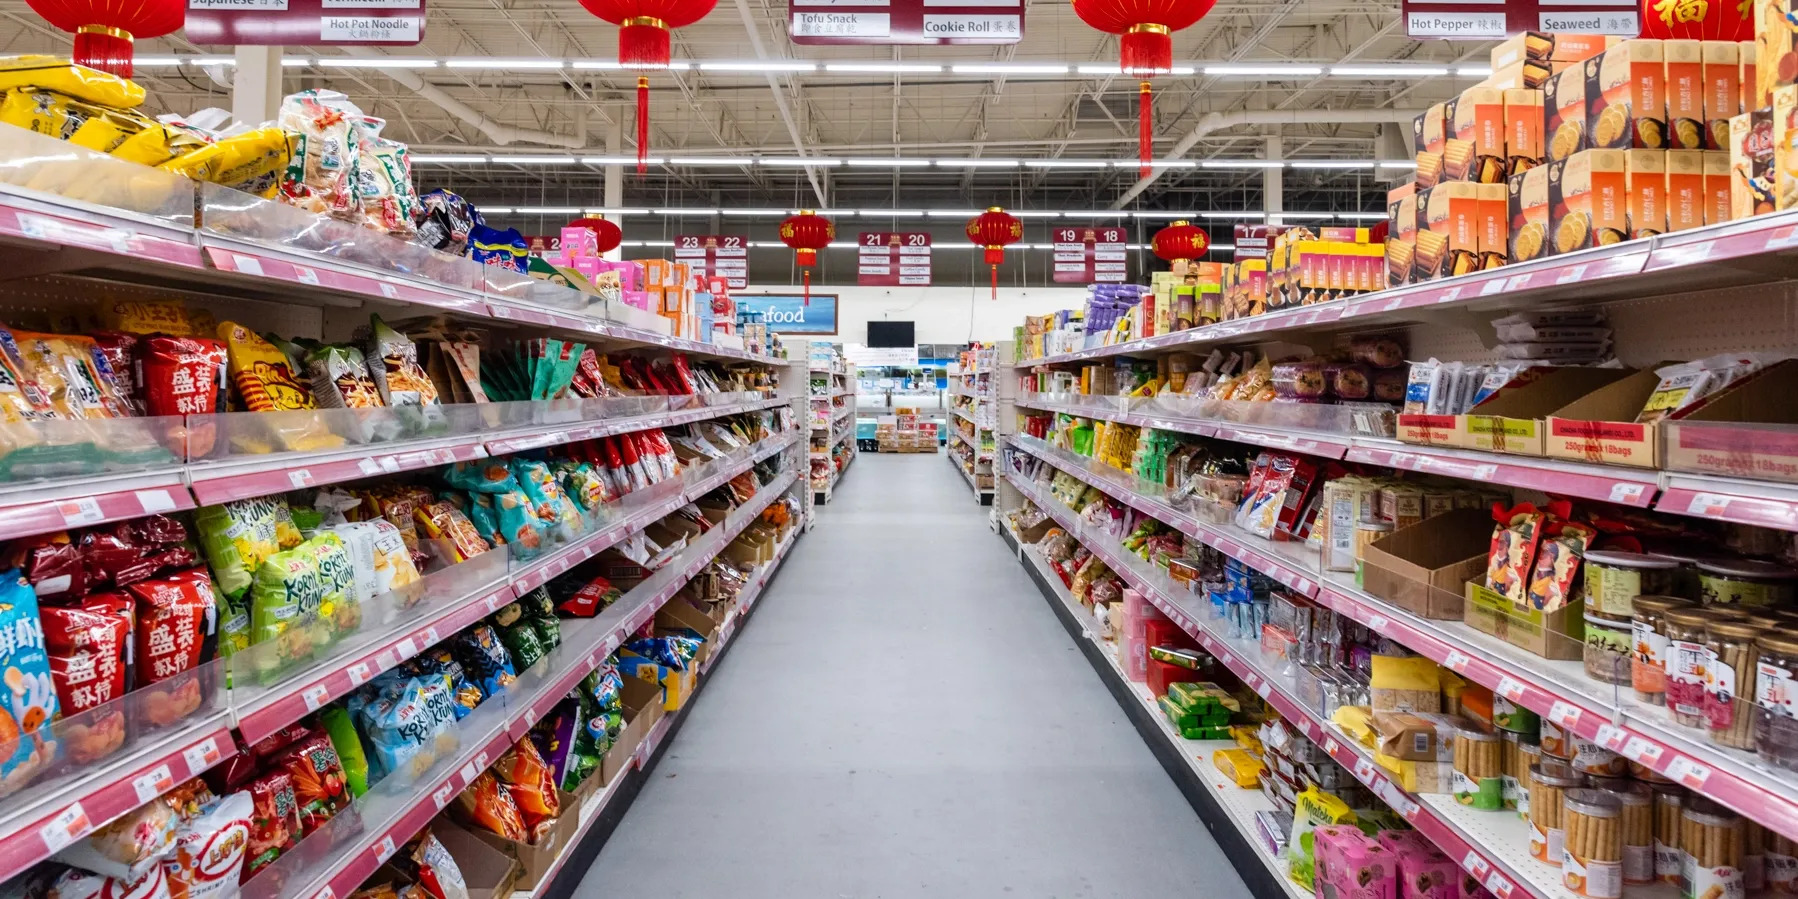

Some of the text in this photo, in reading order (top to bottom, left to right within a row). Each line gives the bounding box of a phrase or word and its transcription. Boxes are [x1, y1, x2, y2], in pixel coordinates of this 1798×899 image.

[330, 19, 409, 28] Hot Pot Noodle
[801, 13, 857, 23] Tofu Snack
[1544, 18, 1600, 30] Seaweed
[925, 21, 990, 32] Cookie Roll
[1411, 19, 1474, 31] Hot Pepper
[1060, 230, 1076, 242] 19
[1103, 230, 1118, 242] 18
[1242, 227, 1257, 238] 17
[682, 237, 699, 248] 23
[724, 237, 740, 248] 22
[867, 234, 881, 246] 21
[908, 234, 925, 246] 20
[1191, 233, 1205, 249] 福
[176, 393, 209, 413] 款待
[296, 588, 322, 617] KRUN
[148, 617, 194, 657] 盛装
[65, 642, 117, 685] 盛装
[153, 650, 189, 677] 款待
[70, 679, 112, 709] 款待
[427, 688, 450, 709] ORNY
[1302, 796, 1334, 824] Matcha
[204, 829, 246, 872] 上好佳
